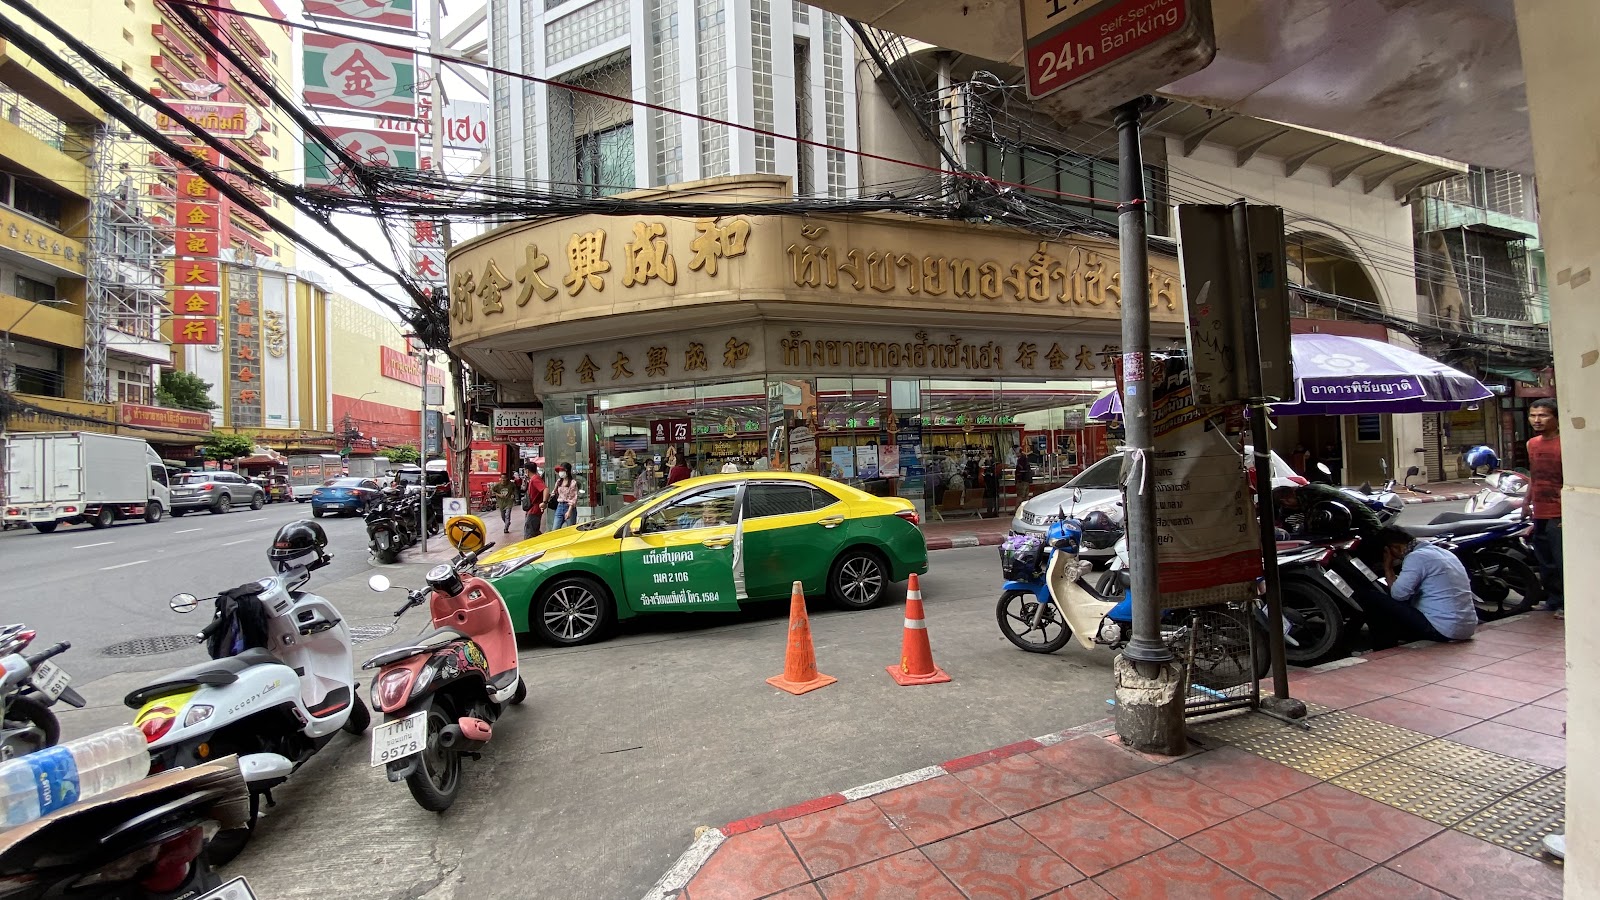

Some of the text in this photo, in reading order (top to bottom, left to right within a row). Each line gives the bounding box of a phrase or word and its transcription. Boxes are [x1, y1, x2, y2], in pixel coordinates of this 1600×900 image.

[1101, 6, 1178, 54] Banking
[1037, 41, 1095, 85] 24h
[1311, 378, 1413, 395] อาคารพิชัยญาติ
[674, 422, 688, 438] 75
[643, 547, 694, 566] แท็กซี่บุคคล
[51, 675, 69, 695] 5911
[228, 692, 261, 715] SCOOPY
[381, 740, 418, 762] 9578
